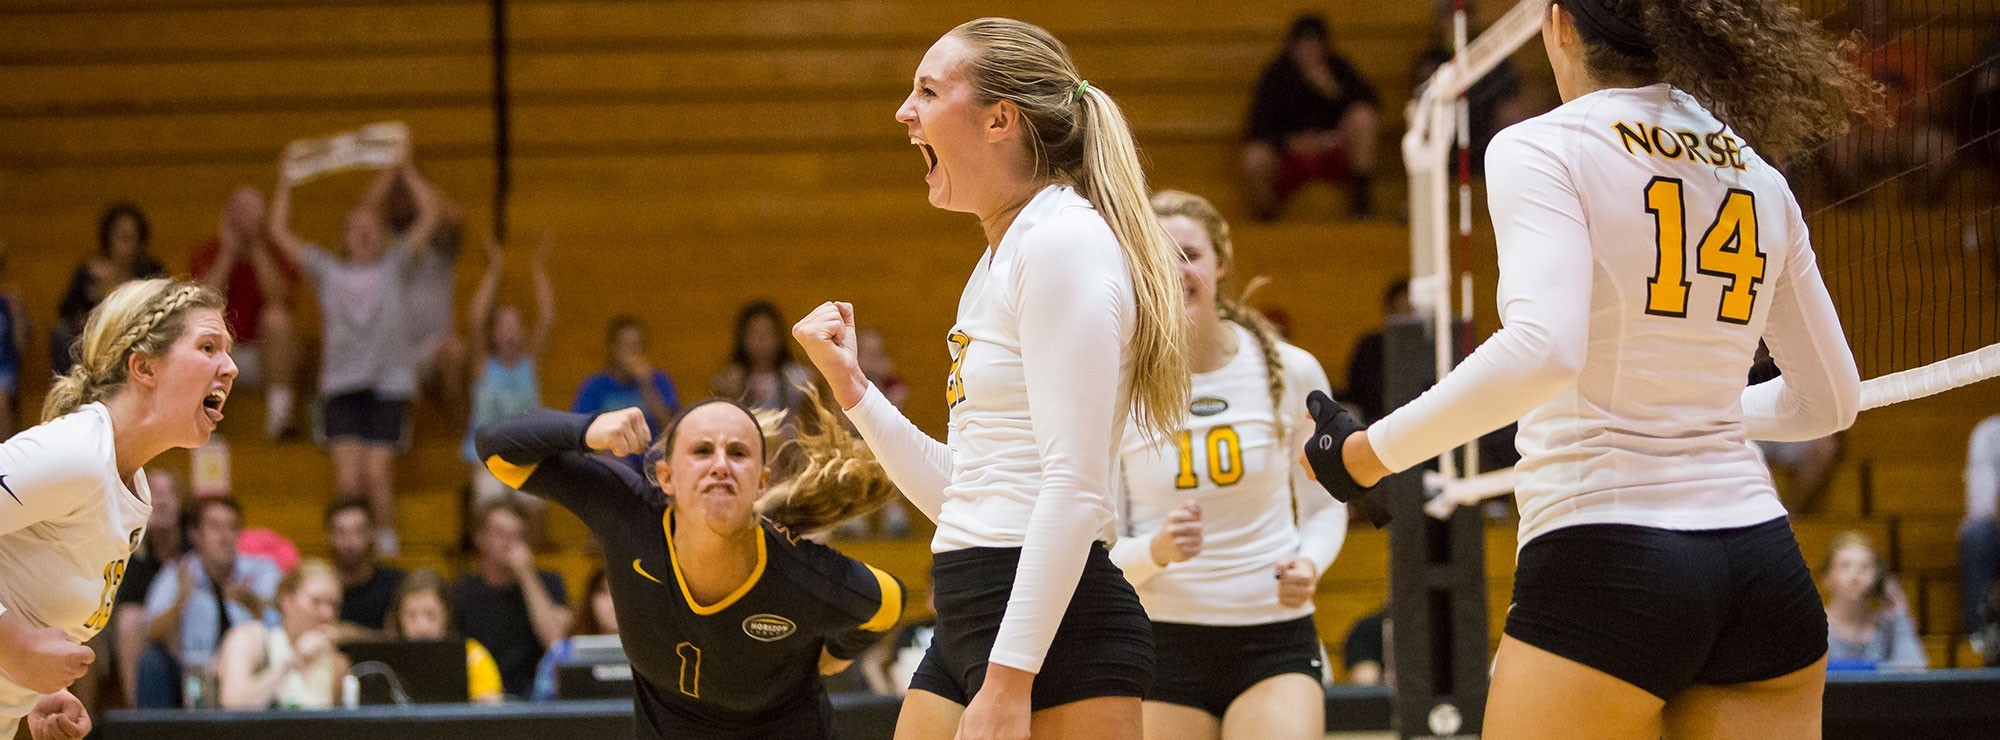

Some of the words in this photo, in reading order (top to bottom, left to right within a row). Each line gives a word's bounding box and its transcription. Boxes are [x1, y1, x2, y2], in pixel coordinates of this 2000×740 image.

[1612, 120, 1747, 171] NORSE
[1643, 175, 1767, 325] 14
[1175, 424, 1244, 490] 10
[676, 641, 701, 698] 1
